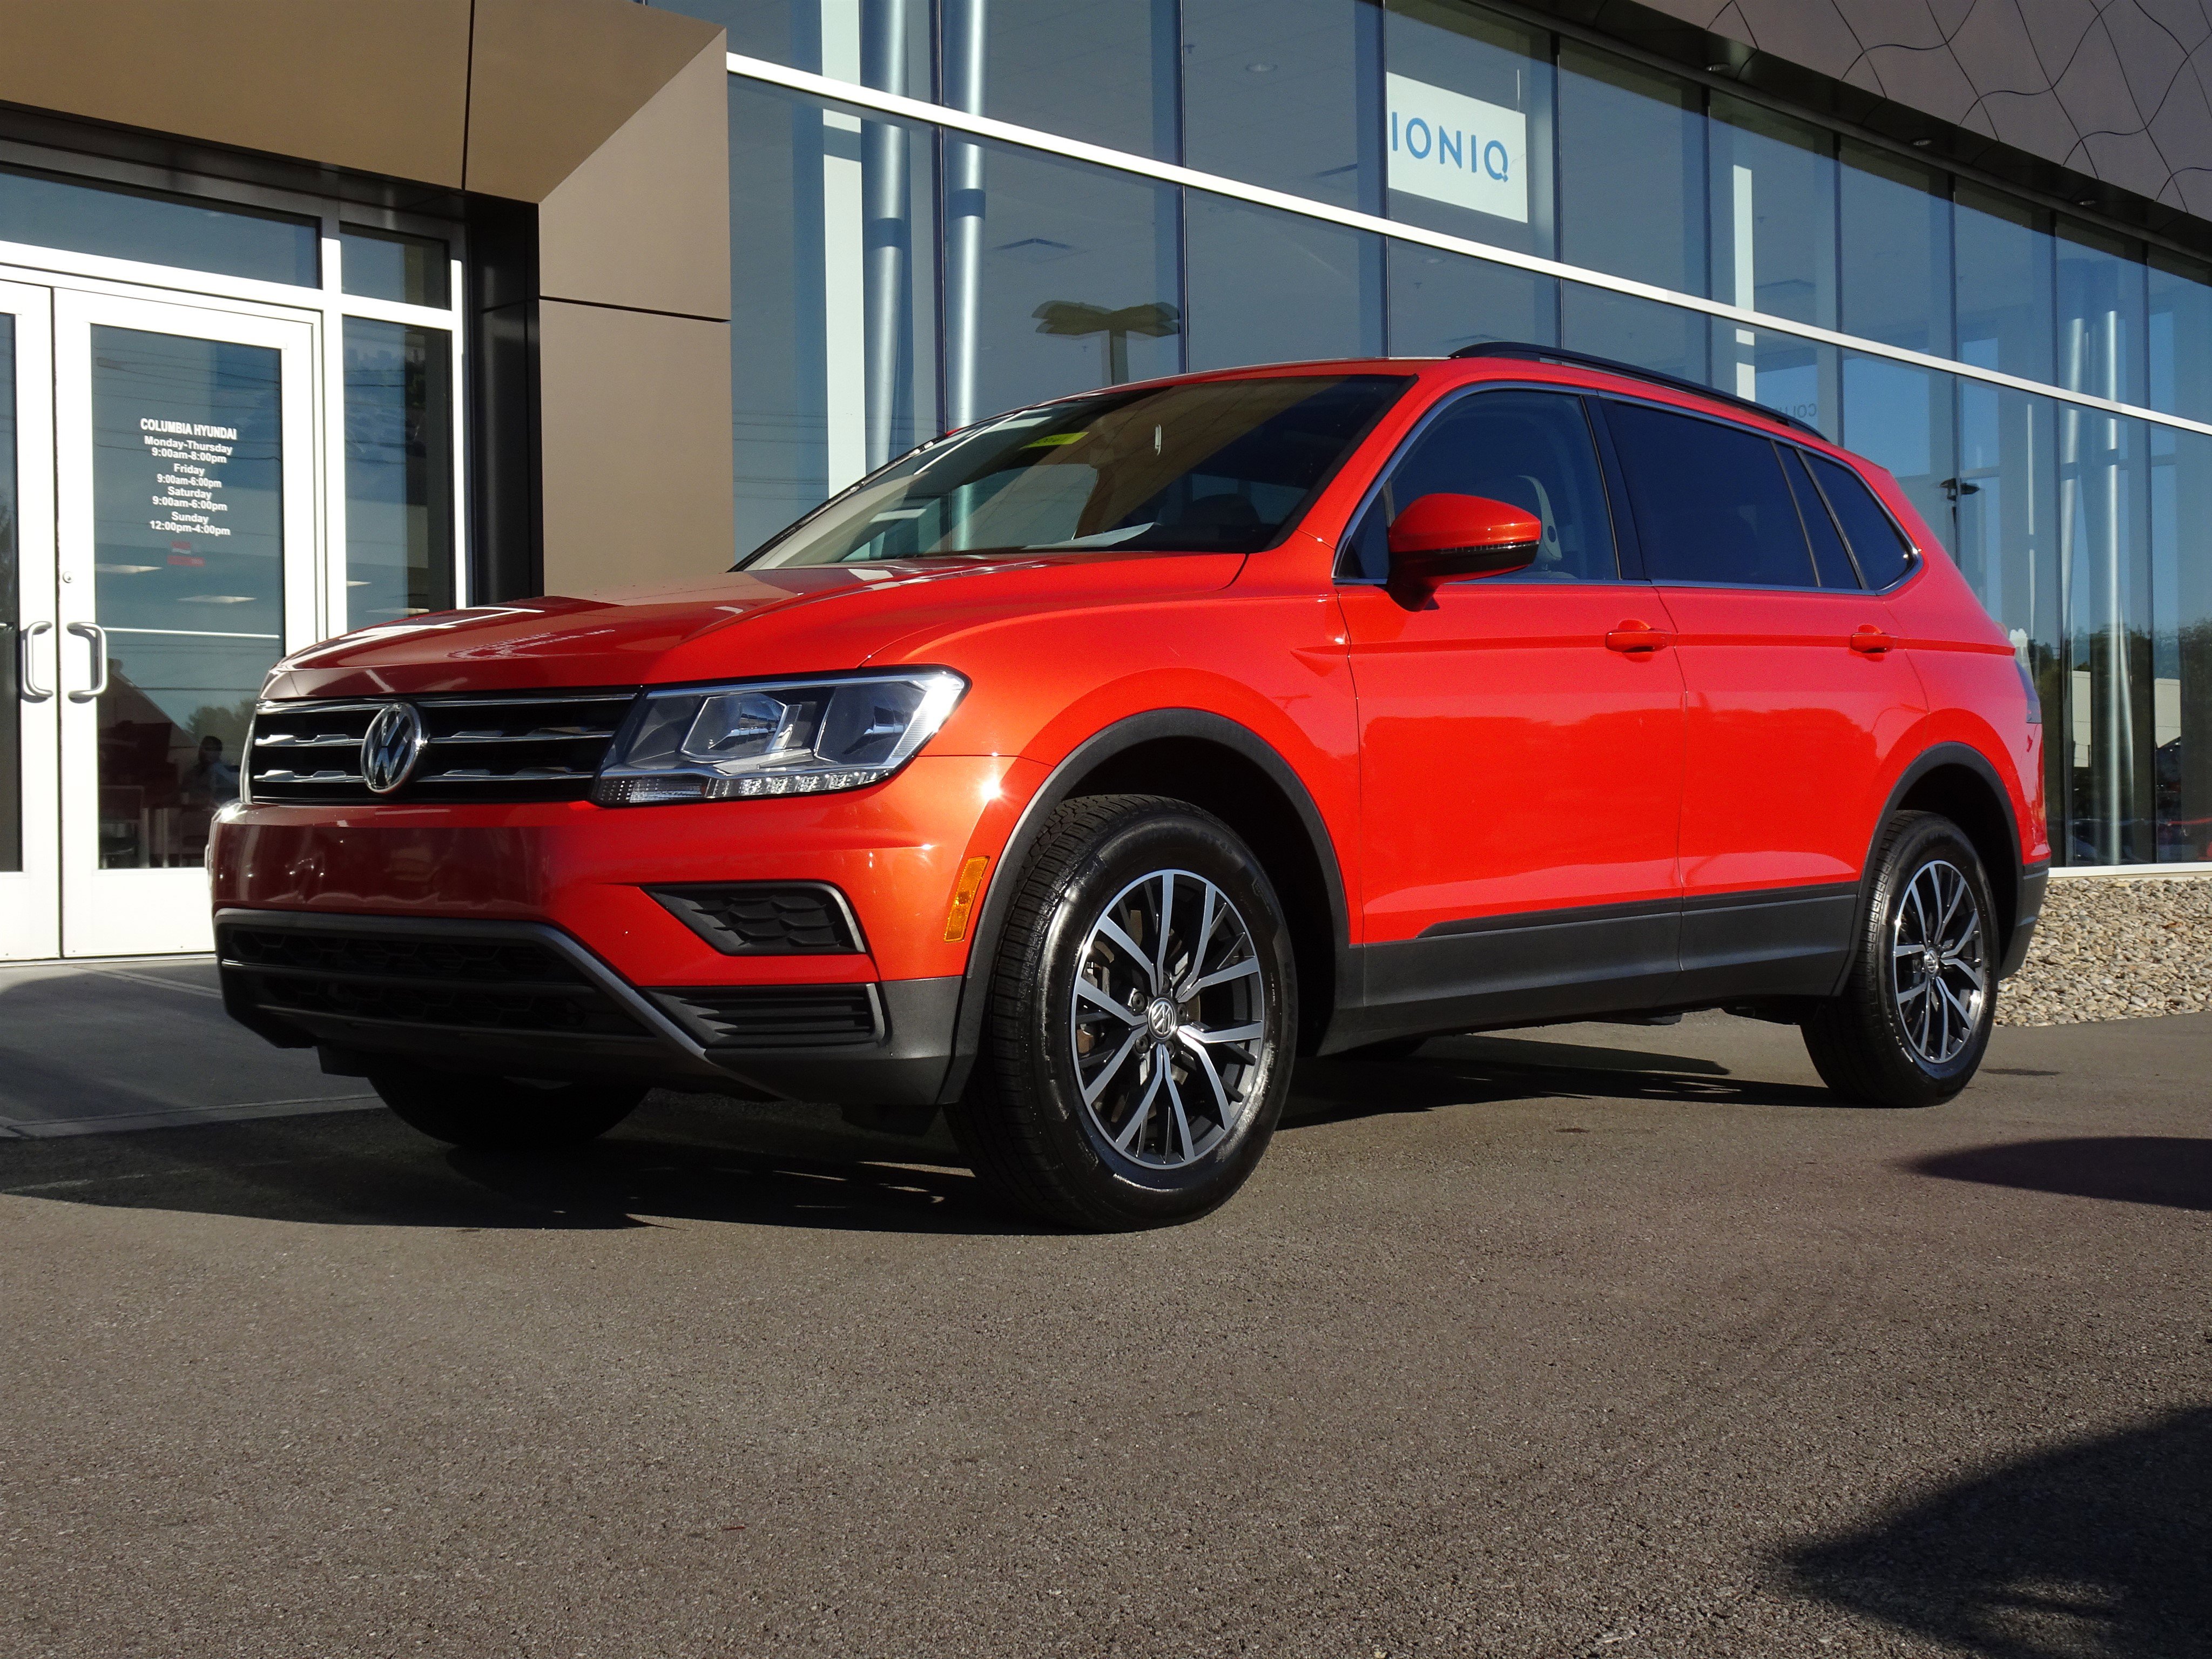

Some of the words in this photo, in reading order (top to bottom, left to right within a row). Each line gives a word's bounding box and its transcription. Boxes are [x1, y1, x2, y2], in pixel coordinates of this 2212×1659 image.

[1392, 112, 1508, 183] IONIQ
[140, 418, 192, 435] COLUMBIA
[194, 424, 237, 440] HYUNDAI
[144, 436, 233, 455] Monday-Thursday
[151, 447, 227, 464] 9:00am-8:00pm
[173, 463, 205, 476] Friday
[157, 474, 222, 489] 9:00am-6:00pm
[167, 486, 212, 500] Saturday
[152, 496, 227, 511] 9:00am-6:00pm
[171, 511, 209, 525] Sunday
[150, 520, 231, 536] 12:00pm-4:00pm
[362, 703, 420, 792] VW
